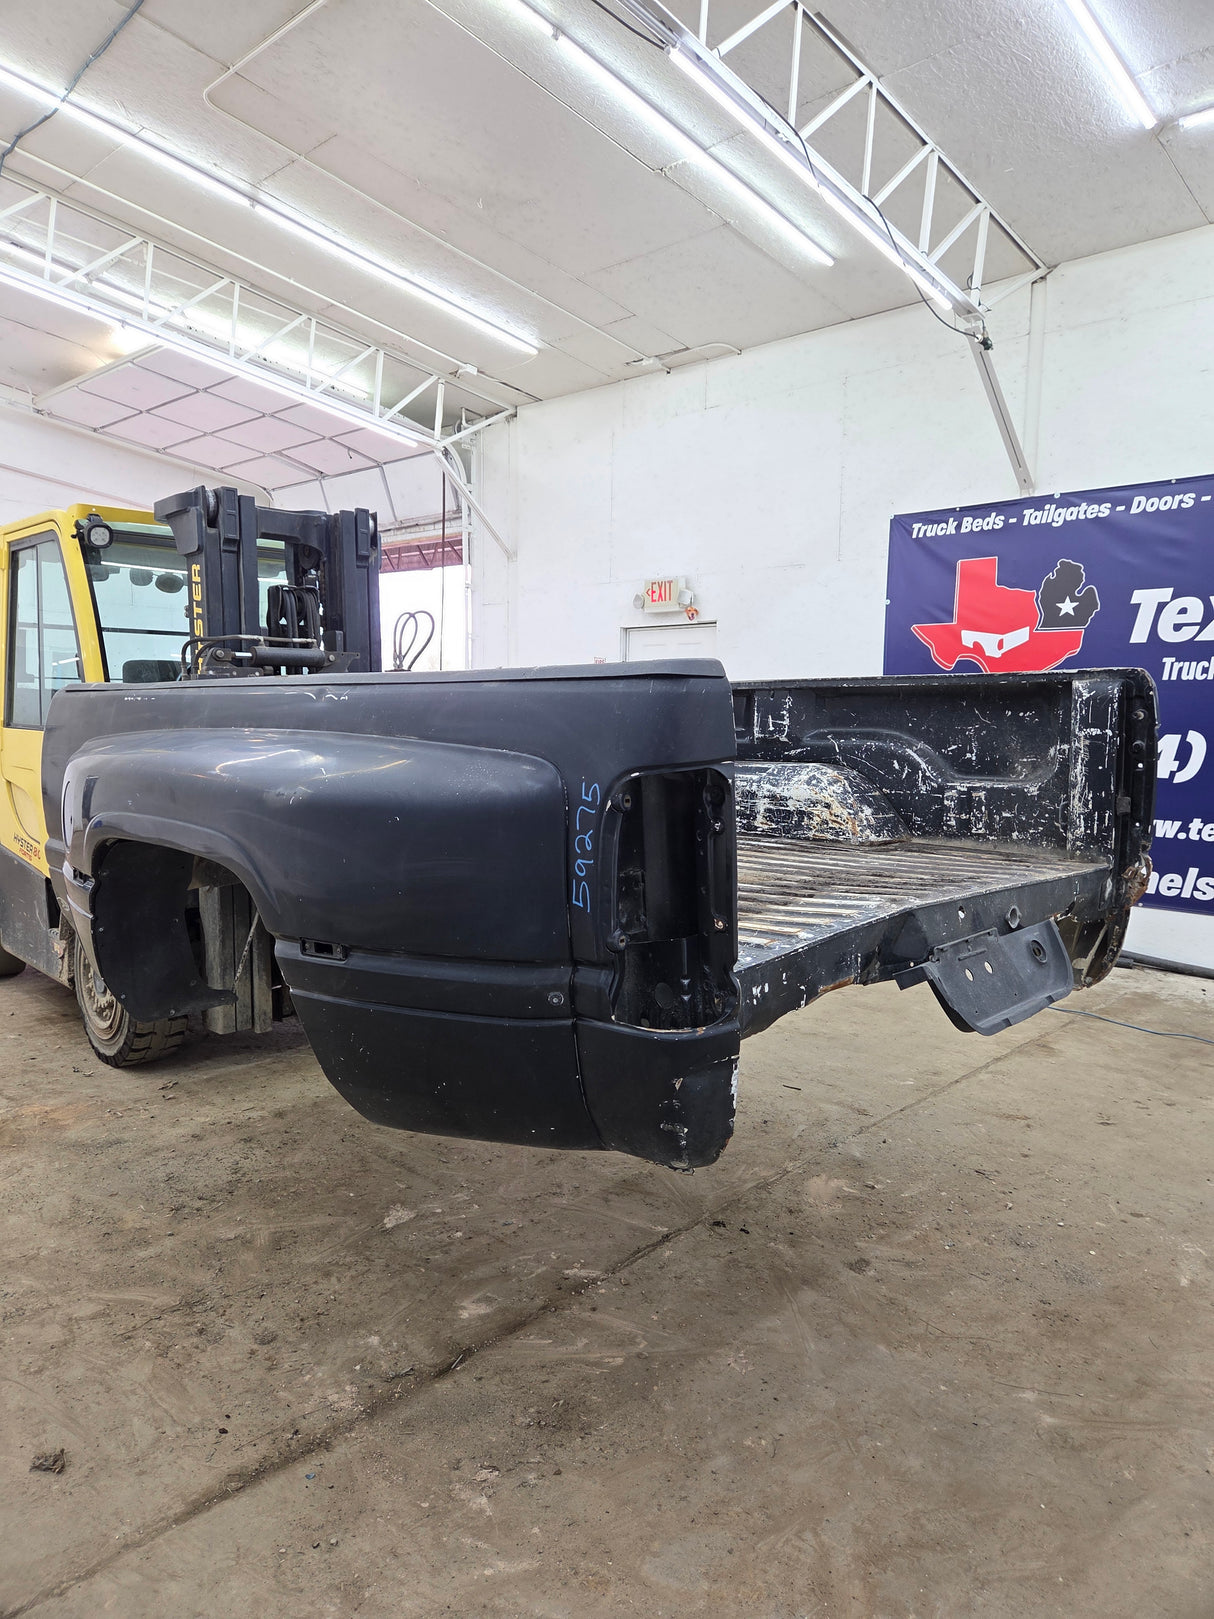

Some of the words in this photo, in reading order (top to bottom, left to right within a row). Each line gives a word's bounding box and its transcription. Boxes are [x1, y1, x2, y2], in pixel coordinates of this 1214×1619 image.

[911, 517, 958, 539] Truck
[960, 512, 1005, 534] Beds
[1022, 502, 1112, 528] Tailgates
[1129, 492, 1196, 515] Doors
[191, 563, 205, 675] STER
[651, 580, 673, 603] EXIT
[572, 781, 600, 913] 59275
